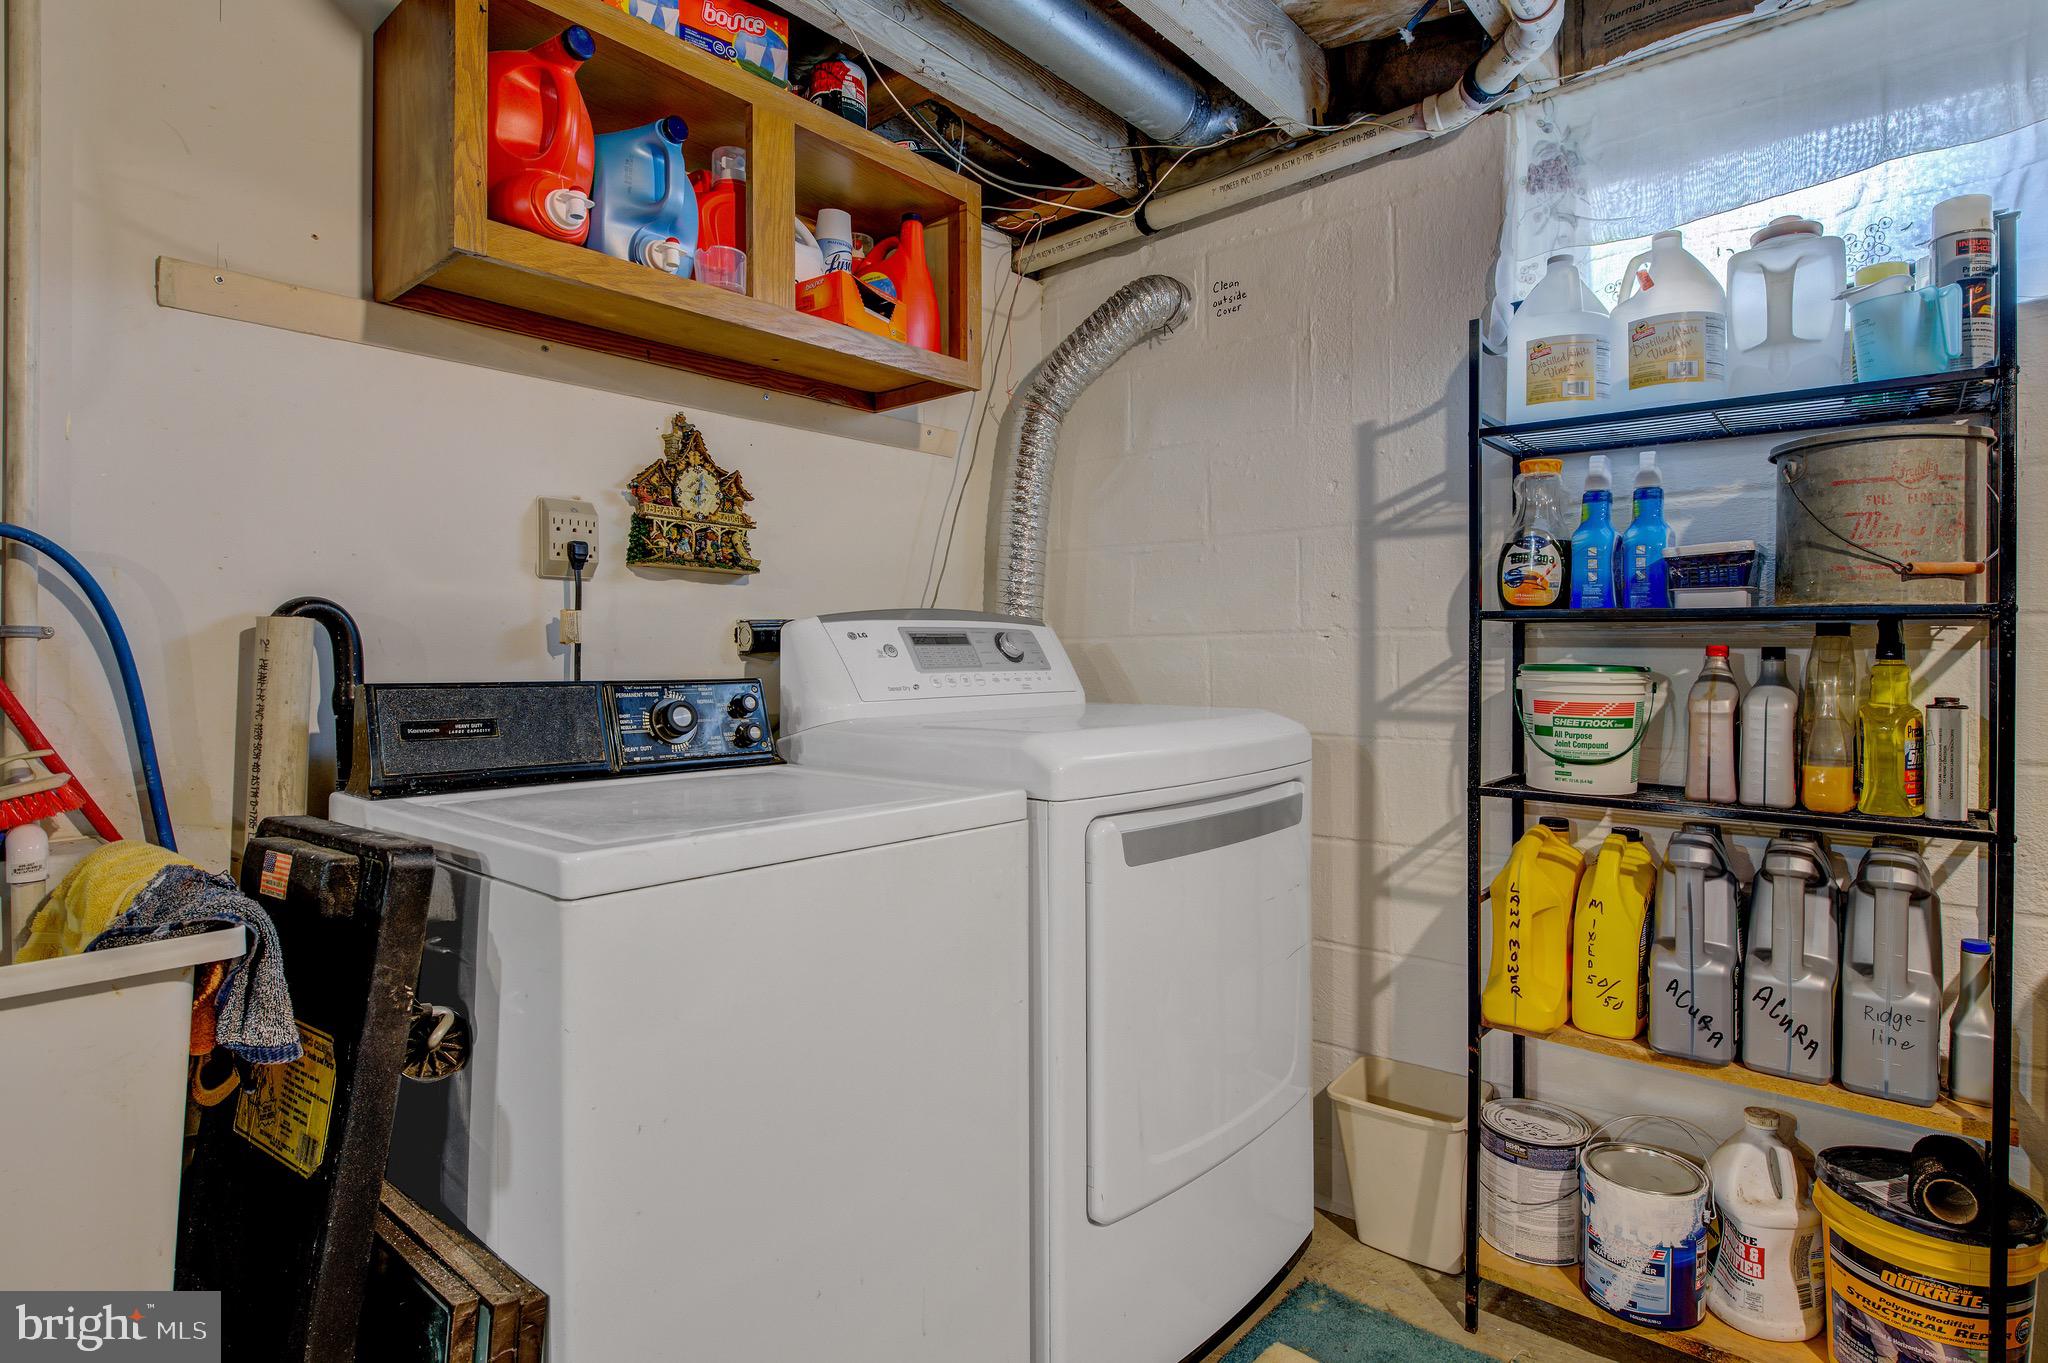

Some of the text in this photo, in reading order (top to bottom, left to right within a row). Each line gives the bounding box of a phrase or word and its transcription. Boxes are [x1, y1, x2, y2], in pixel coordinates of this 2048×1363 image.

[704, 2, 766, 34] bounce
[1603, 1, 1645, 24] Thermal
[1219, 180, 1240, 193] PIONEER
[1240, 176, 1251, 186] PVC
[1251, 172, 1262, 182] 1120
[1263, 168, 1273, 178] SCH
[1281, 159, 1295, 170] ASTM
[1342, 136, 1357, 148] ASTM
[1213, 281, 1240, 293] Clean
[1213, 291, 1247, 308] outside
[1630, 333, 1671, 359] Distilled
[1529, 353, 1567, 376] Distilled
[255, 703, 267, 721] PVC
[1553, 717, 1615, 728] SHEETROCK
[253, 723, 264, 742] 1120
[1554, 730, 1593, 741] All Purpose
[252, 743, 263, 760] SCH
[1554, 740, 1609, 751] Joint Compound
[251, 761, 262, 773] 40
[250, 774, 261, 799] ASTM
[1508, 882, 1523, 999] LAWN MOWER
[1587, 898, 1604, 969] MIXED
[1864, 1005, 1926, 1031] Ridge-
[1871, 1027, 1917, 1051] line
[1749, 1248, 1759, 1263] &
[1880, 1269, 1984, 1309] QUIKRETE
[1897, 1272, 1973, 1296] COMMERCIAL GRADE
[1846, 1285, 2012, 1341] STRUCTURAL REPR
[1879, 1296, 1976, 1331] Polymer Modified
[1892, 1338, 1924, 1355] Horizontal
